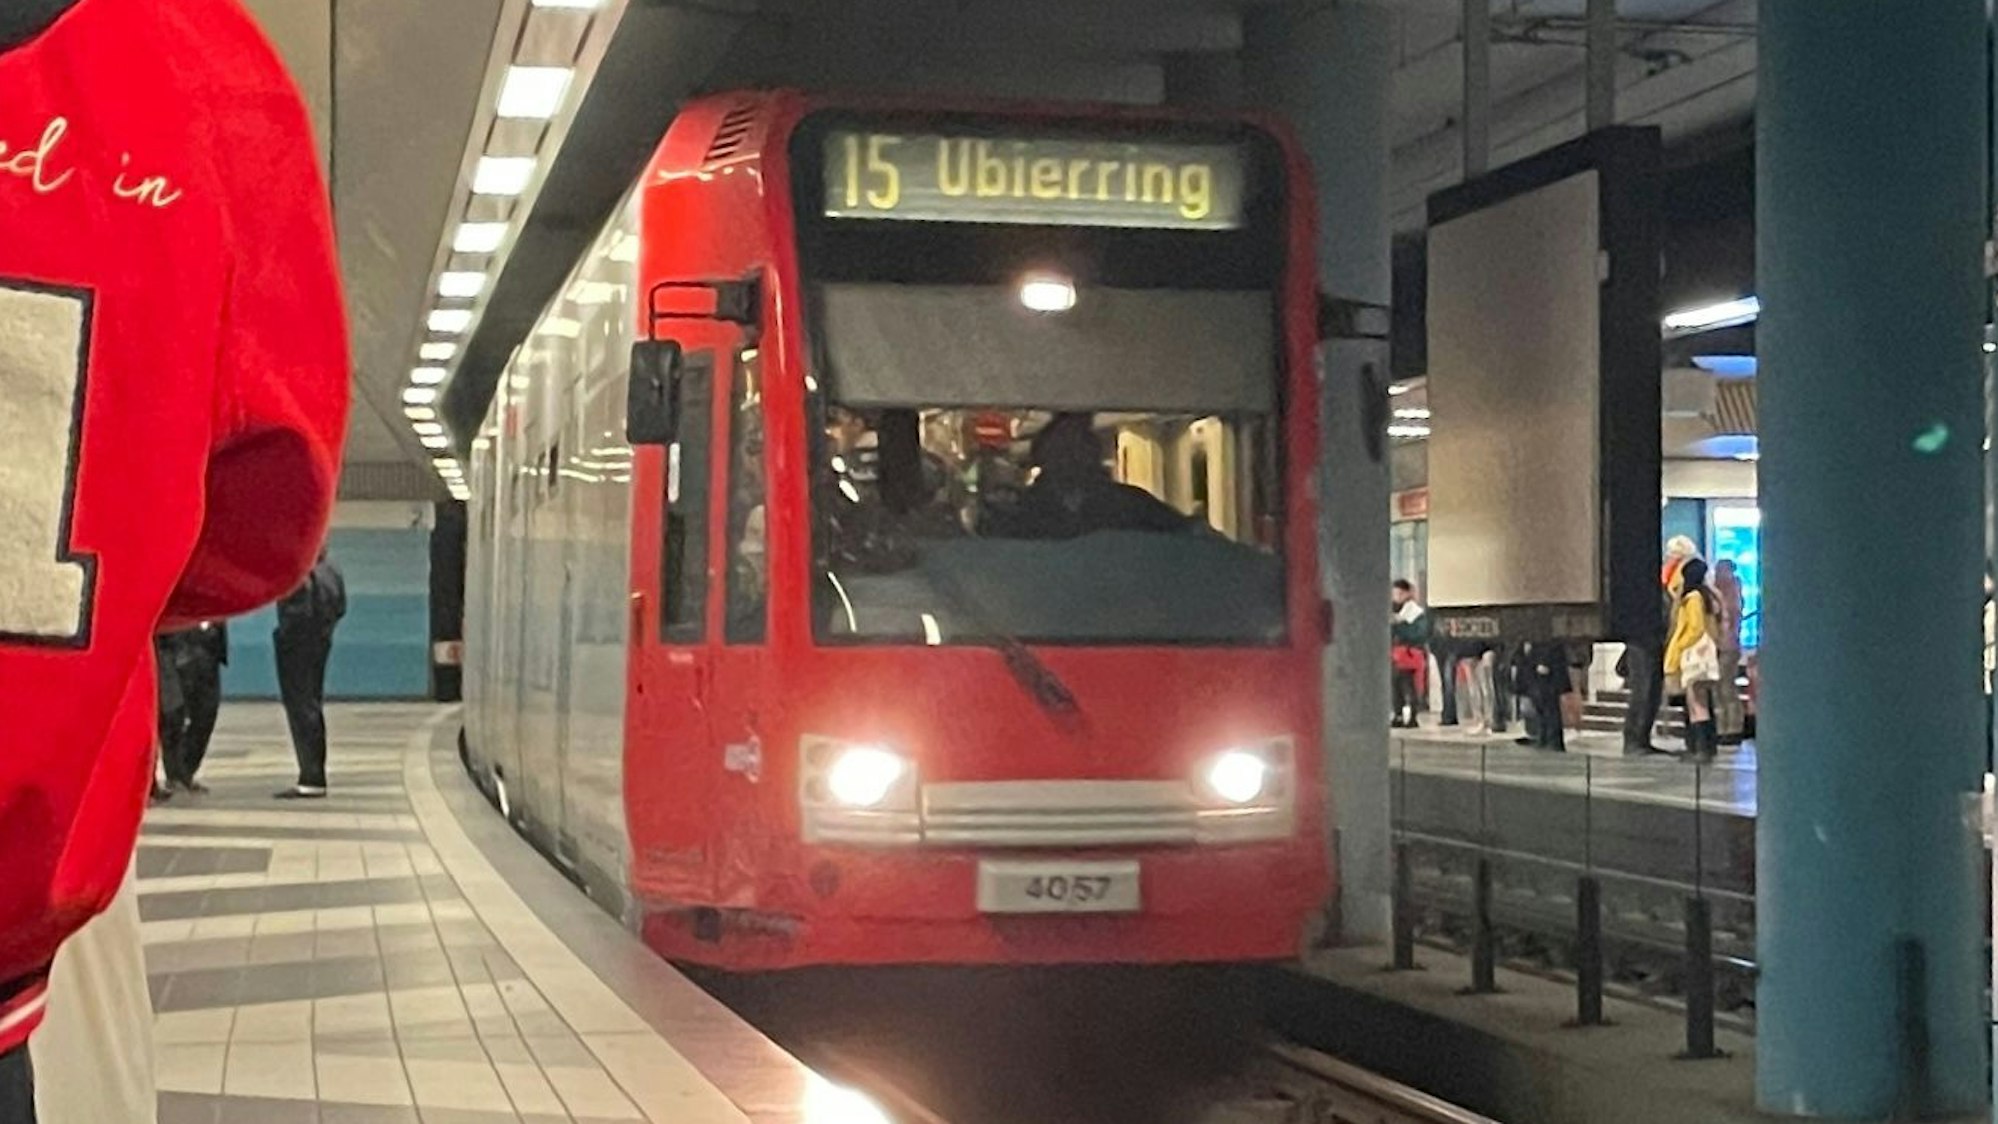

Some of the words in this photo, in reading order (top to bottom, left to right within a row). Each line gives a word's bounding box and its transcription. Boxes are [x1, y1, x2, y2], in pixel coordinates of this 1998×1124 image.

[113, 151, 183, 207] in
[844, 134, 901, 210] 15
[937, 137, 1213, 220] Ubierring
[1025, 875, 1112, 902] 4057
